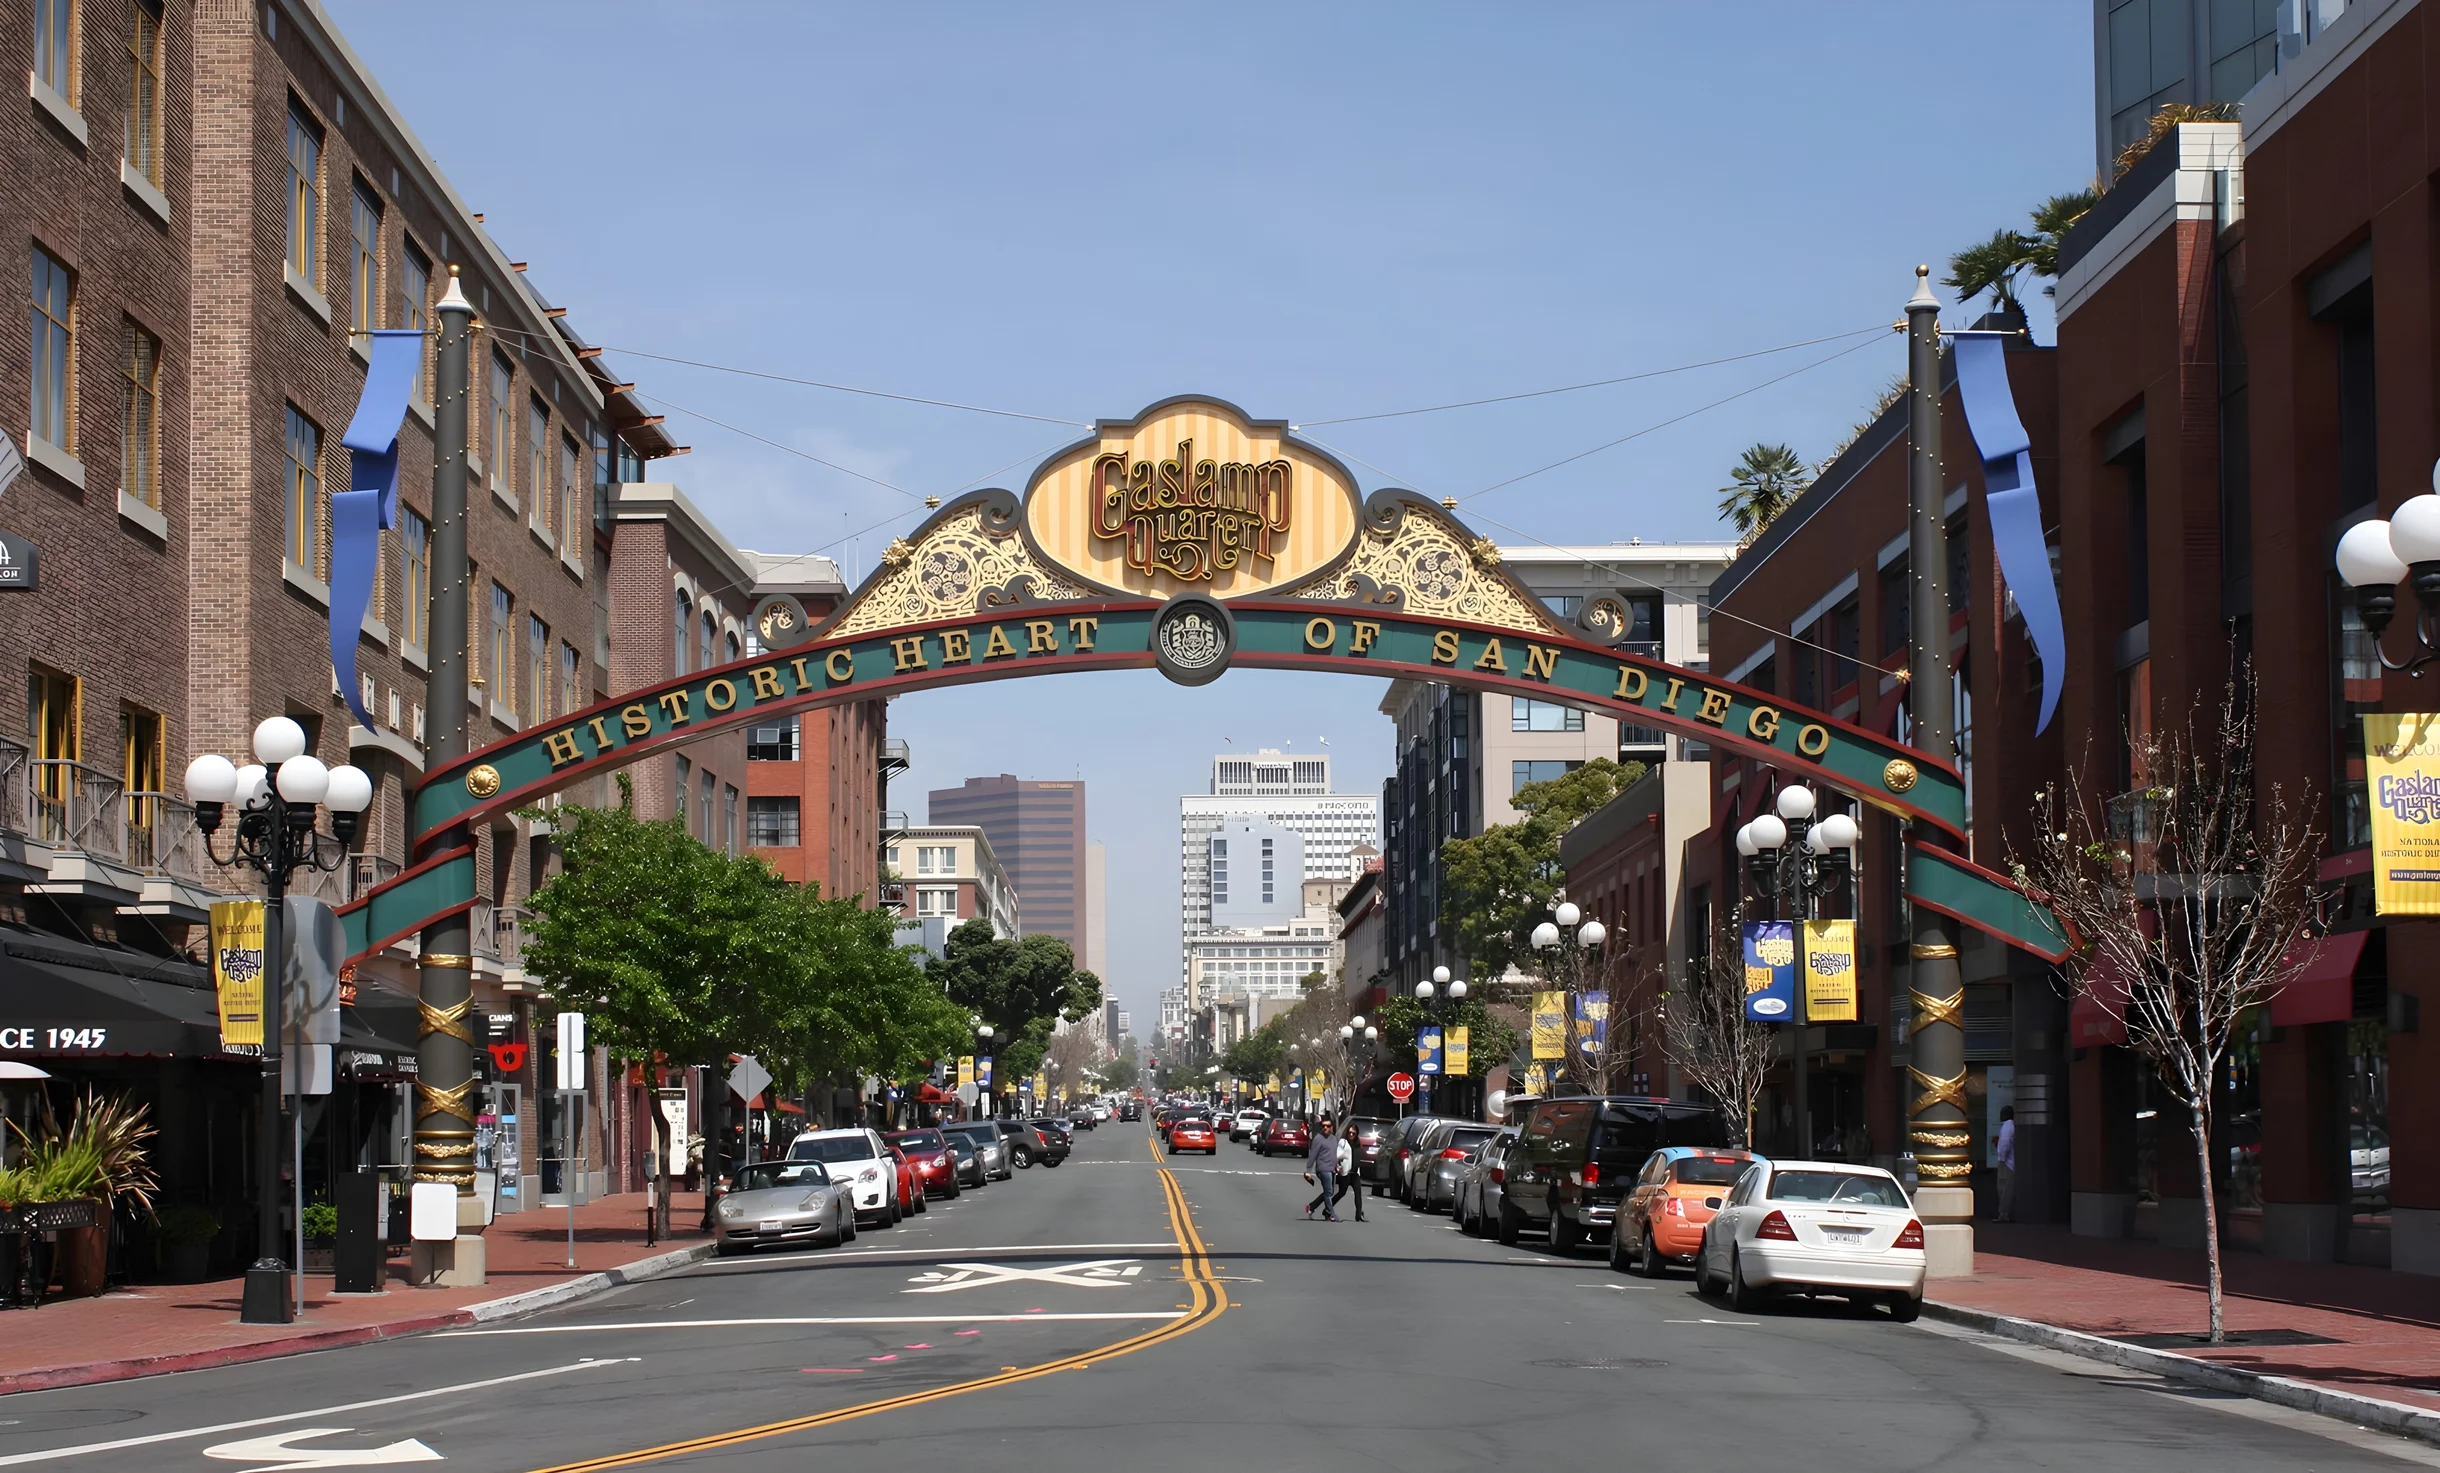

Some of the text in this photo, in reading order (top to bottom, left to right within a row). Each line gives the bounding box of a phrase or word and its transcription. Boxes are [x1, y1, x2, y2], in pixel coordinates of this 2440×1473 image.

[1091, 438, 1293, 562] Gaslamp
[1126, 508, 1264, 582] Quarter
[541, 650, 855, 767] HISTORIC
[890, 617, 1098, 670] HEART
[1304, 617, 1380, 653] OF
[1432, 630, 1560, 679] SAN
[1612, 665, 1830, 757] DIEGO
[46, 1028, 106, 1049] 1945
[1389, 1080, 1412, 1091] STOP
